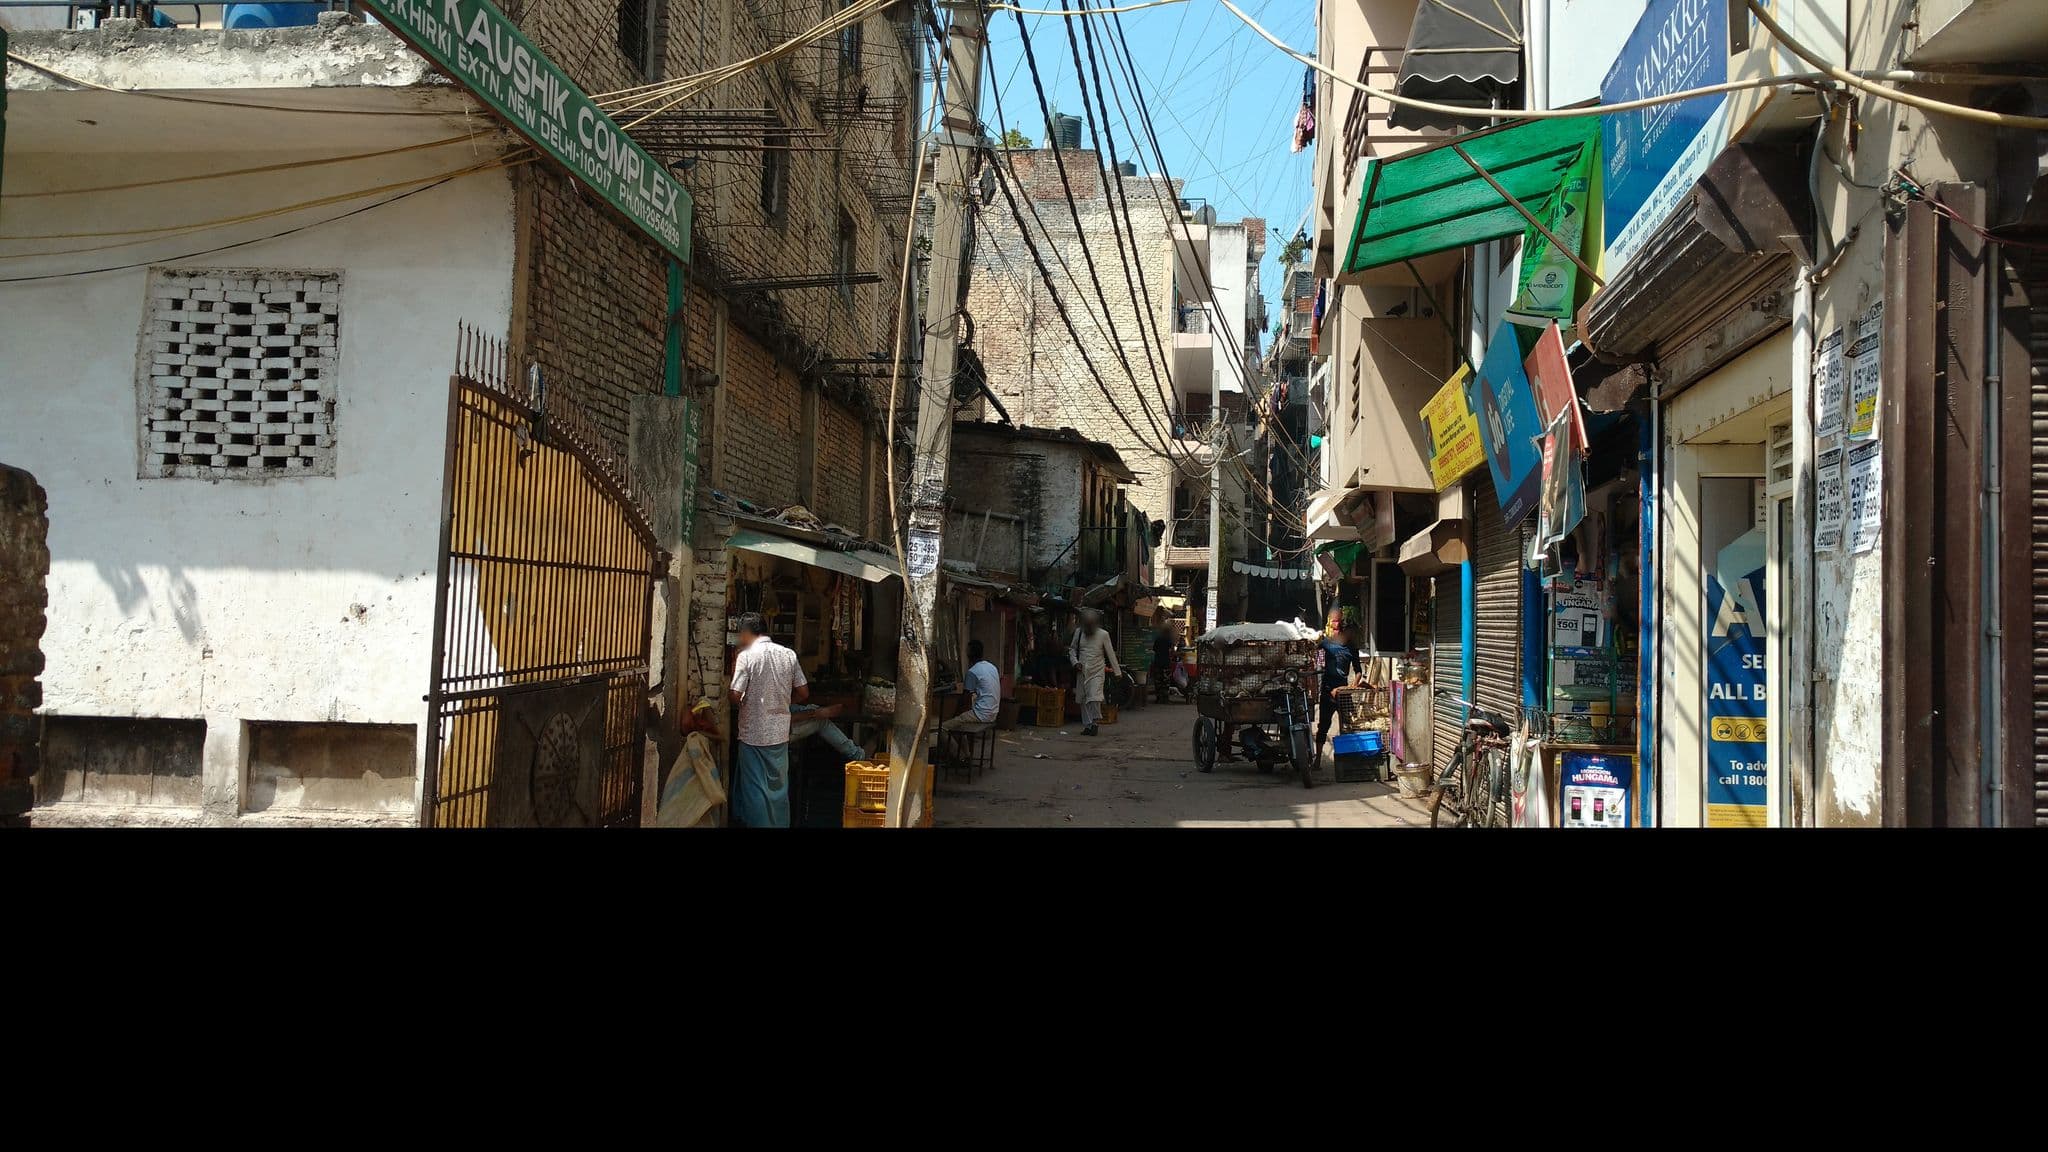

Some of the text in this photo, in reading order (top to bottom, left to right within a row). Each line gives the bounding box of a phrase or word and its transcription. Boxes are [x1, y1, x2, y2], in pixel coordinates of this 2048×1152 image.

[1696, 55, 1710, 82] LIFE
[444, 0, 678, 225] KAUSHIK COMPLEX
[508, 86, 536, 129] NEW
[1851, 476, 1861, 499] 25
[1852, 500, 1862, 521] 50
[909, 542, 918, 553] 25
[909, 552, 918, 562] 50
[1710, 683, 1748, 701] ALL
[1730, 760, 1744, 771] To
[1571, 773, 1619, 786] HUNGAMA
[1719, 774, 1740, 785] call
